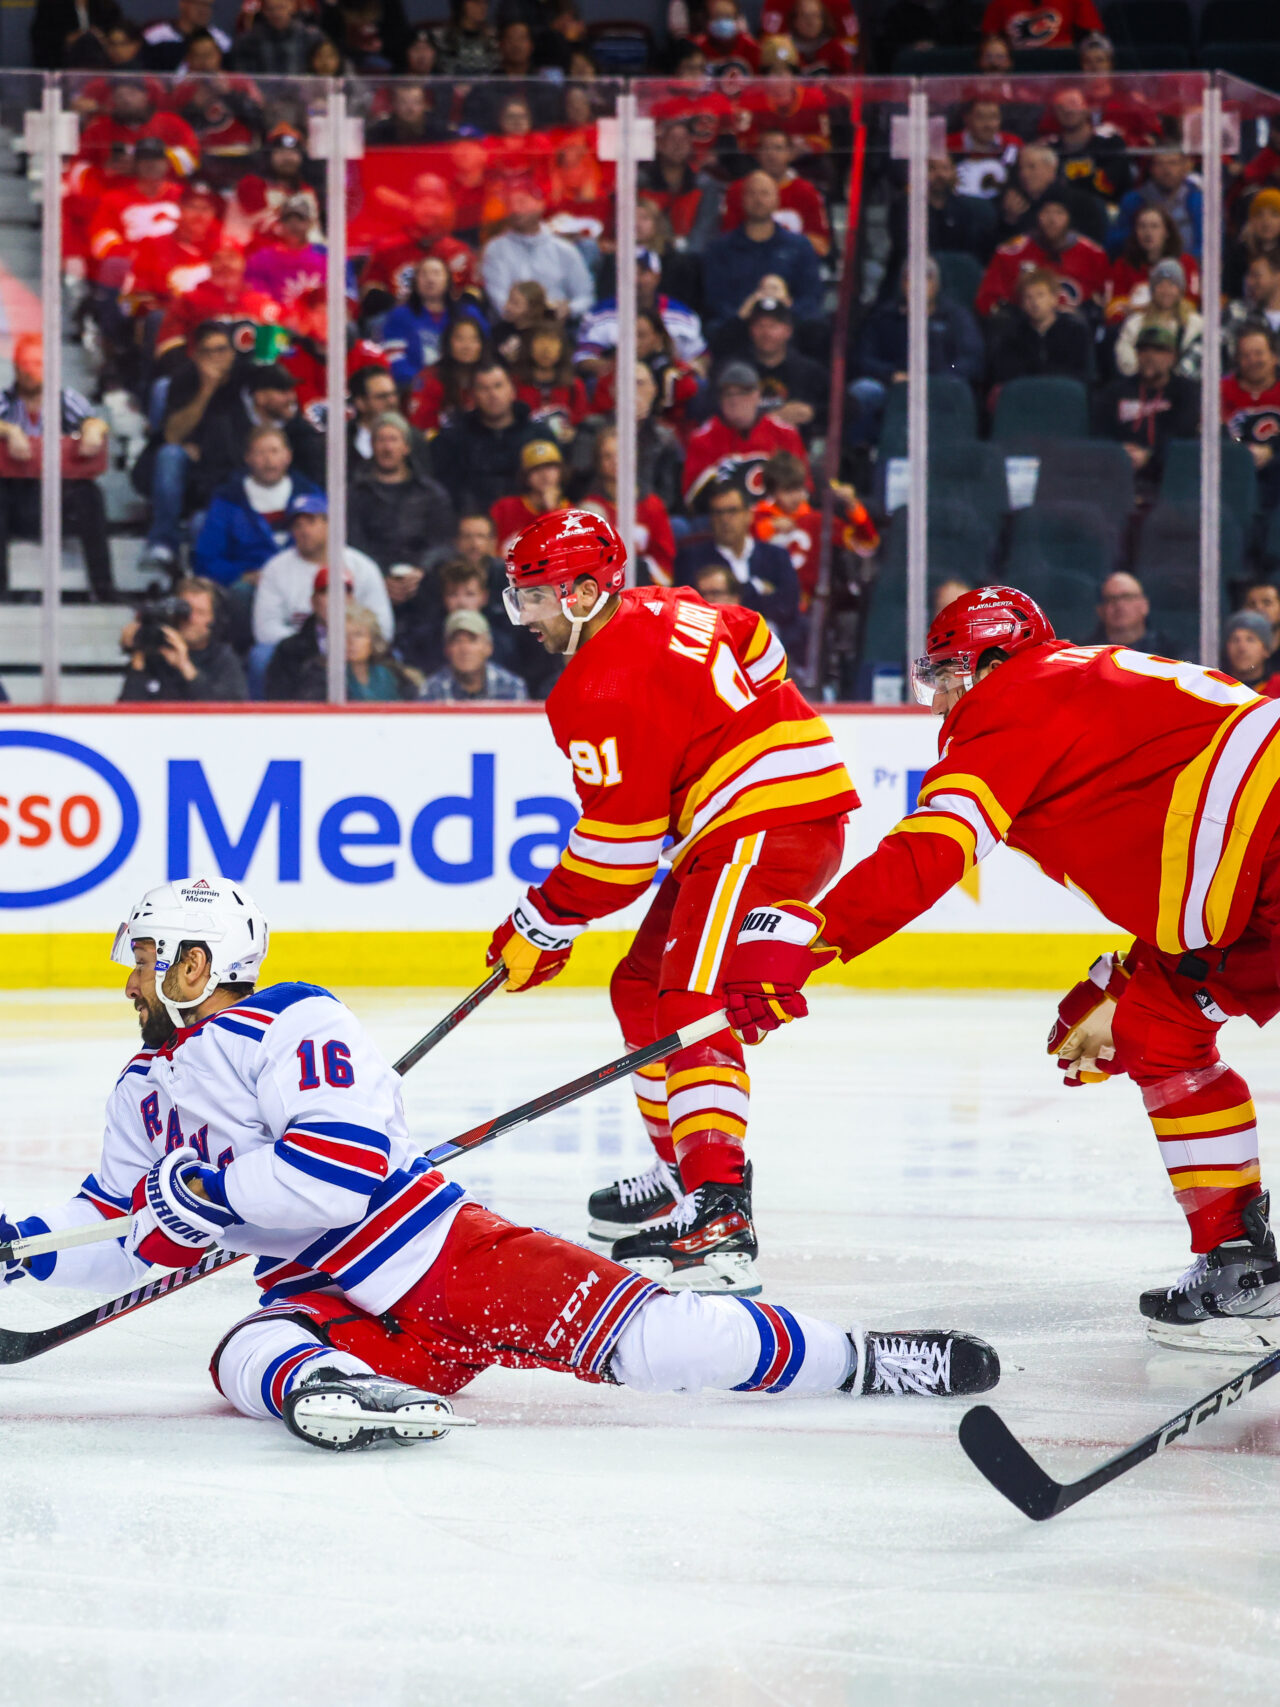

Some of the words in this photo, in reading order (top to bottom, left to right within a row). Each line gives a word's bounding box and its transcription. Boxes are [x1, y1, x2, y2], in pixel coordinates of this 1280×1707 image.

[669, 600, 719, 664] KADRI
[968, 601, 1014, 611] PLAYALBERTA
[569, 736, 623, 788] 91
[167, 753, 582, 886] Meda
[181, 888, 220, 898] Benjamin
[185, 896, 213, 904] Moore
[297, 1039, 355, 1092] 16
[543, 1270, 600, 1349] CCM
[1157, 1373, 1253, 1453] CCM
